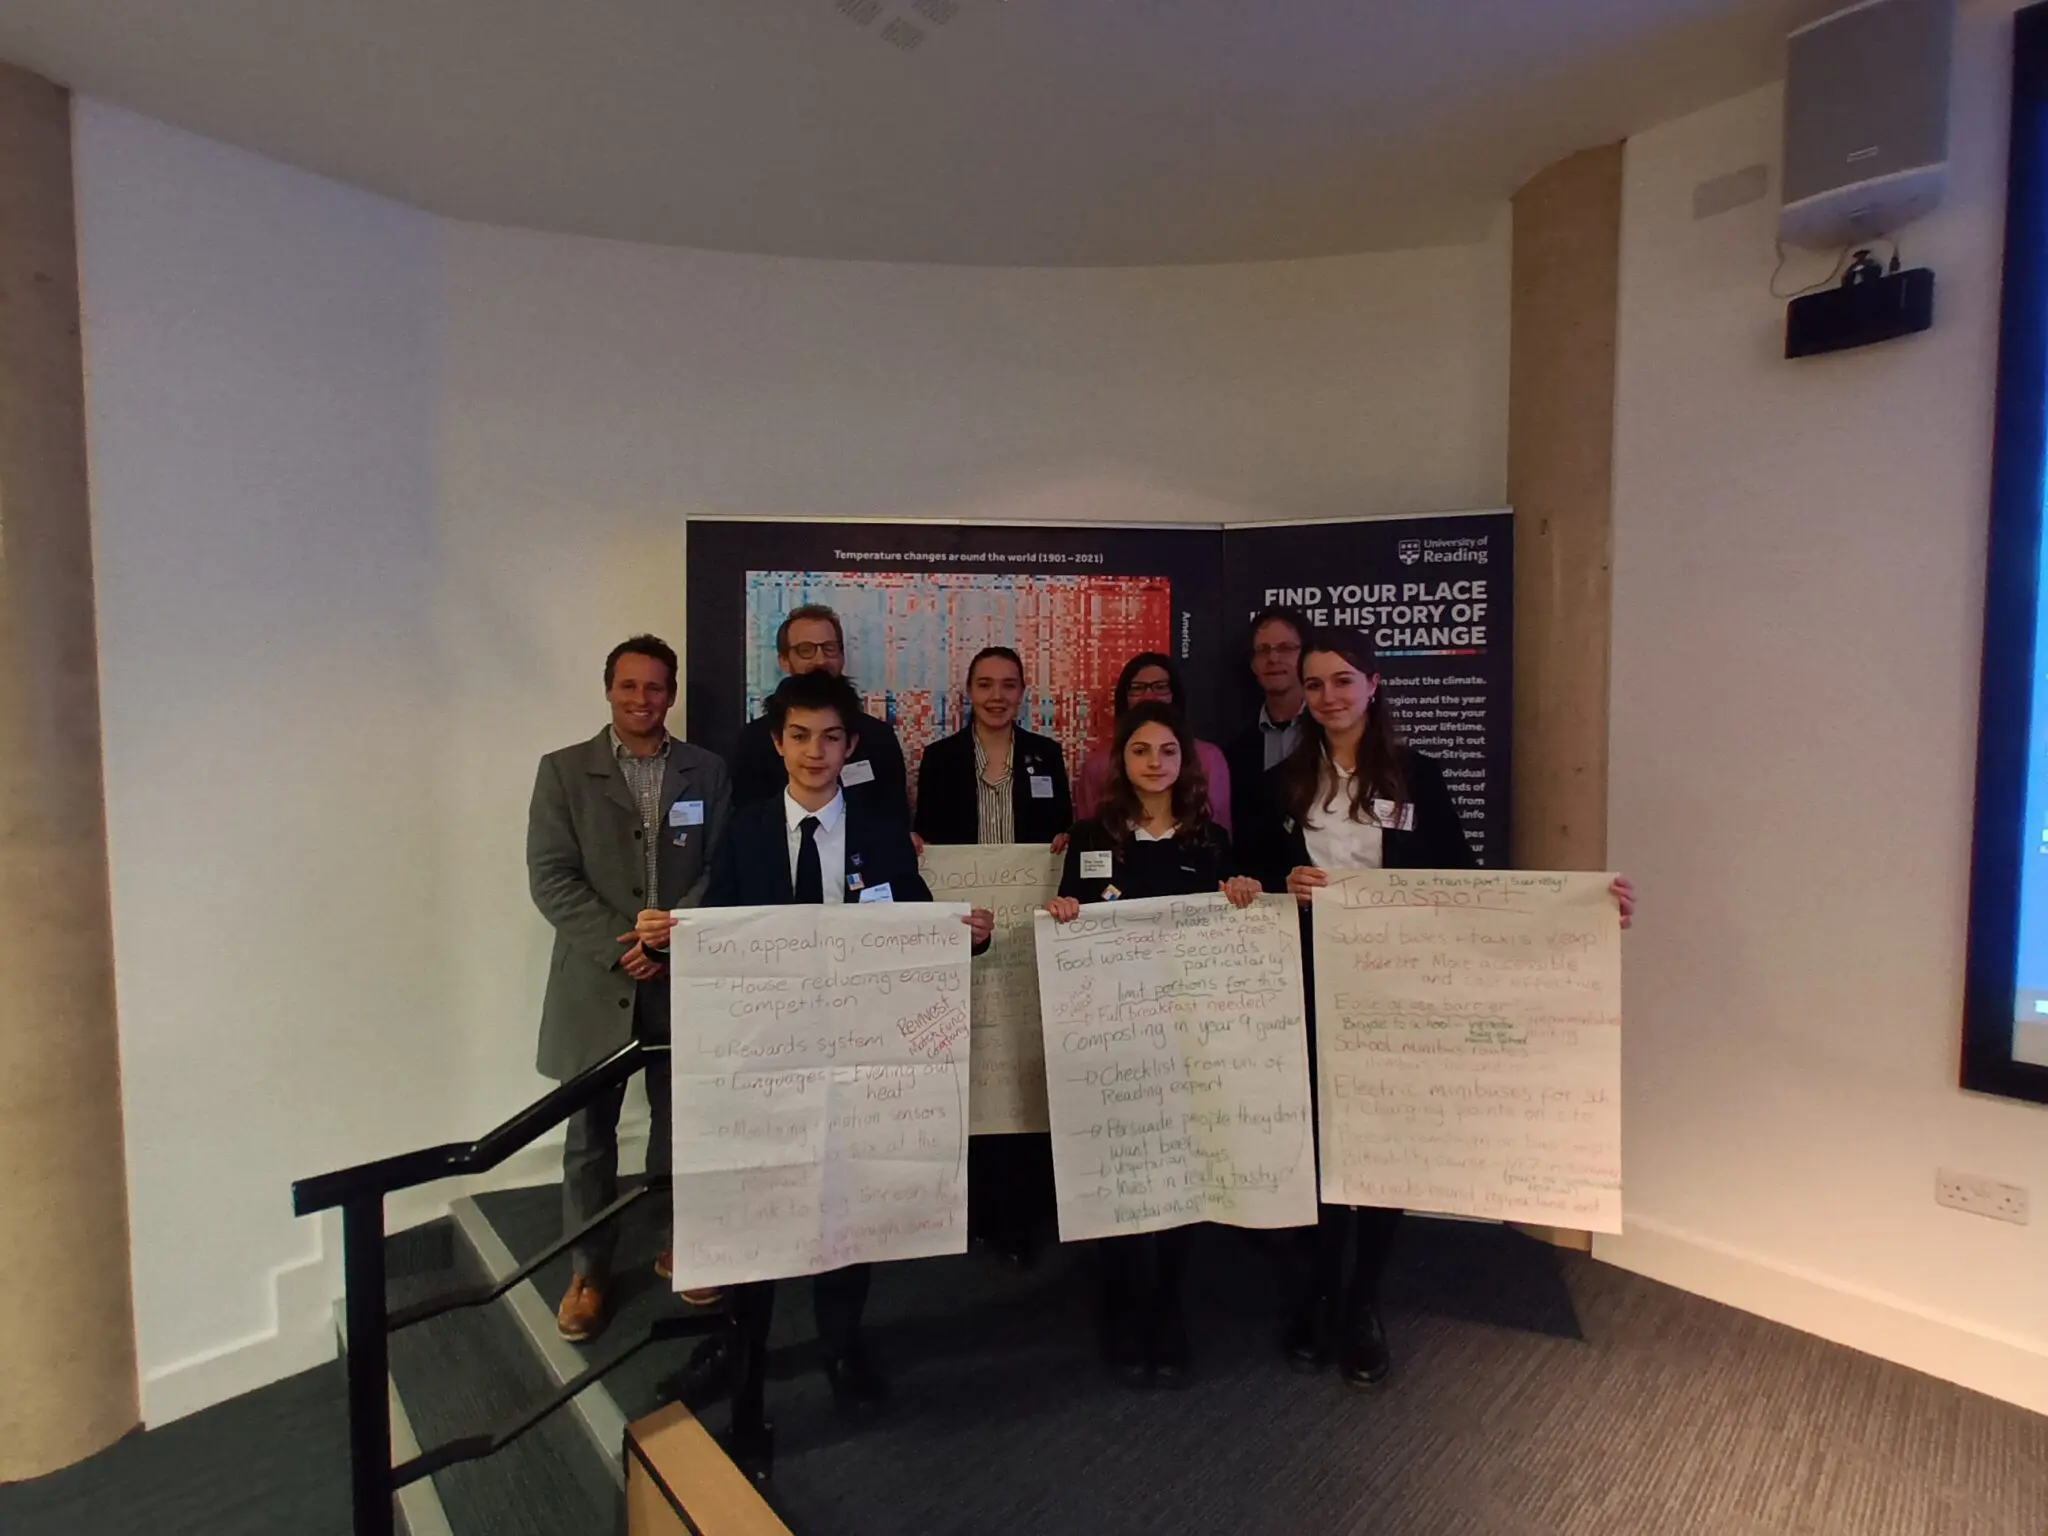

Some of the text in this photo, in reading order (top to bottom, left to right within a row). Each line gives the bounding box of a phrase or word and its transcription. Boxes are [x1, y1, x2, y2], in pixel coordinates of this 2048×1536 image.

[1424, 536, 1488, 549] University of
[833, 549, 901, 562] Temperature
[903, 551, 947, 563] changes
[948, 551, 986, 562] around
[988, 552, 1006, 562] the
[1007, 553, 1037, 563] world
[1424, 549, 1489, 564] Reading
[1264, 581, 1488, 607] FIND YOUR PLACE
[1334, 604, 1446, 626] HISTORY
[1451, 604, 1488, 624] OF
[1375, 626, 1488, 647] CHANGE
[1389, 677, 1420, 686] about
[1422, 677, 1441, 686] the
[1442, 676, 1487, 686] climate.
[1420, 696, 1440, 704] and
[1441, 695, 1460, 704] the
[1461, 696, 1487, 706] year
[1402, 709, 1414, 718] to
[1415, 710, 1434, 718] see
[1436, 709, 1460, 718] how
[1461, 710, 1487, 720] your
[1414, 724, 1438, 734] your
[1440, 722, 1487, 732] lifetime.
[1408, 736, 1454, 747] pointing
[1455, 736, 1465, 745] it
[1466, 737, 1487, 745] out
[1442, 769, 1486, 778] dividual
[1473, 782, 1486, 791] of
[1458, 797, 1485, 805] from
[1334, 875, 1527, 916] Transport
[1055, 949, 1093, 972] Food
[1183, 955, 1284, 977] particularly
